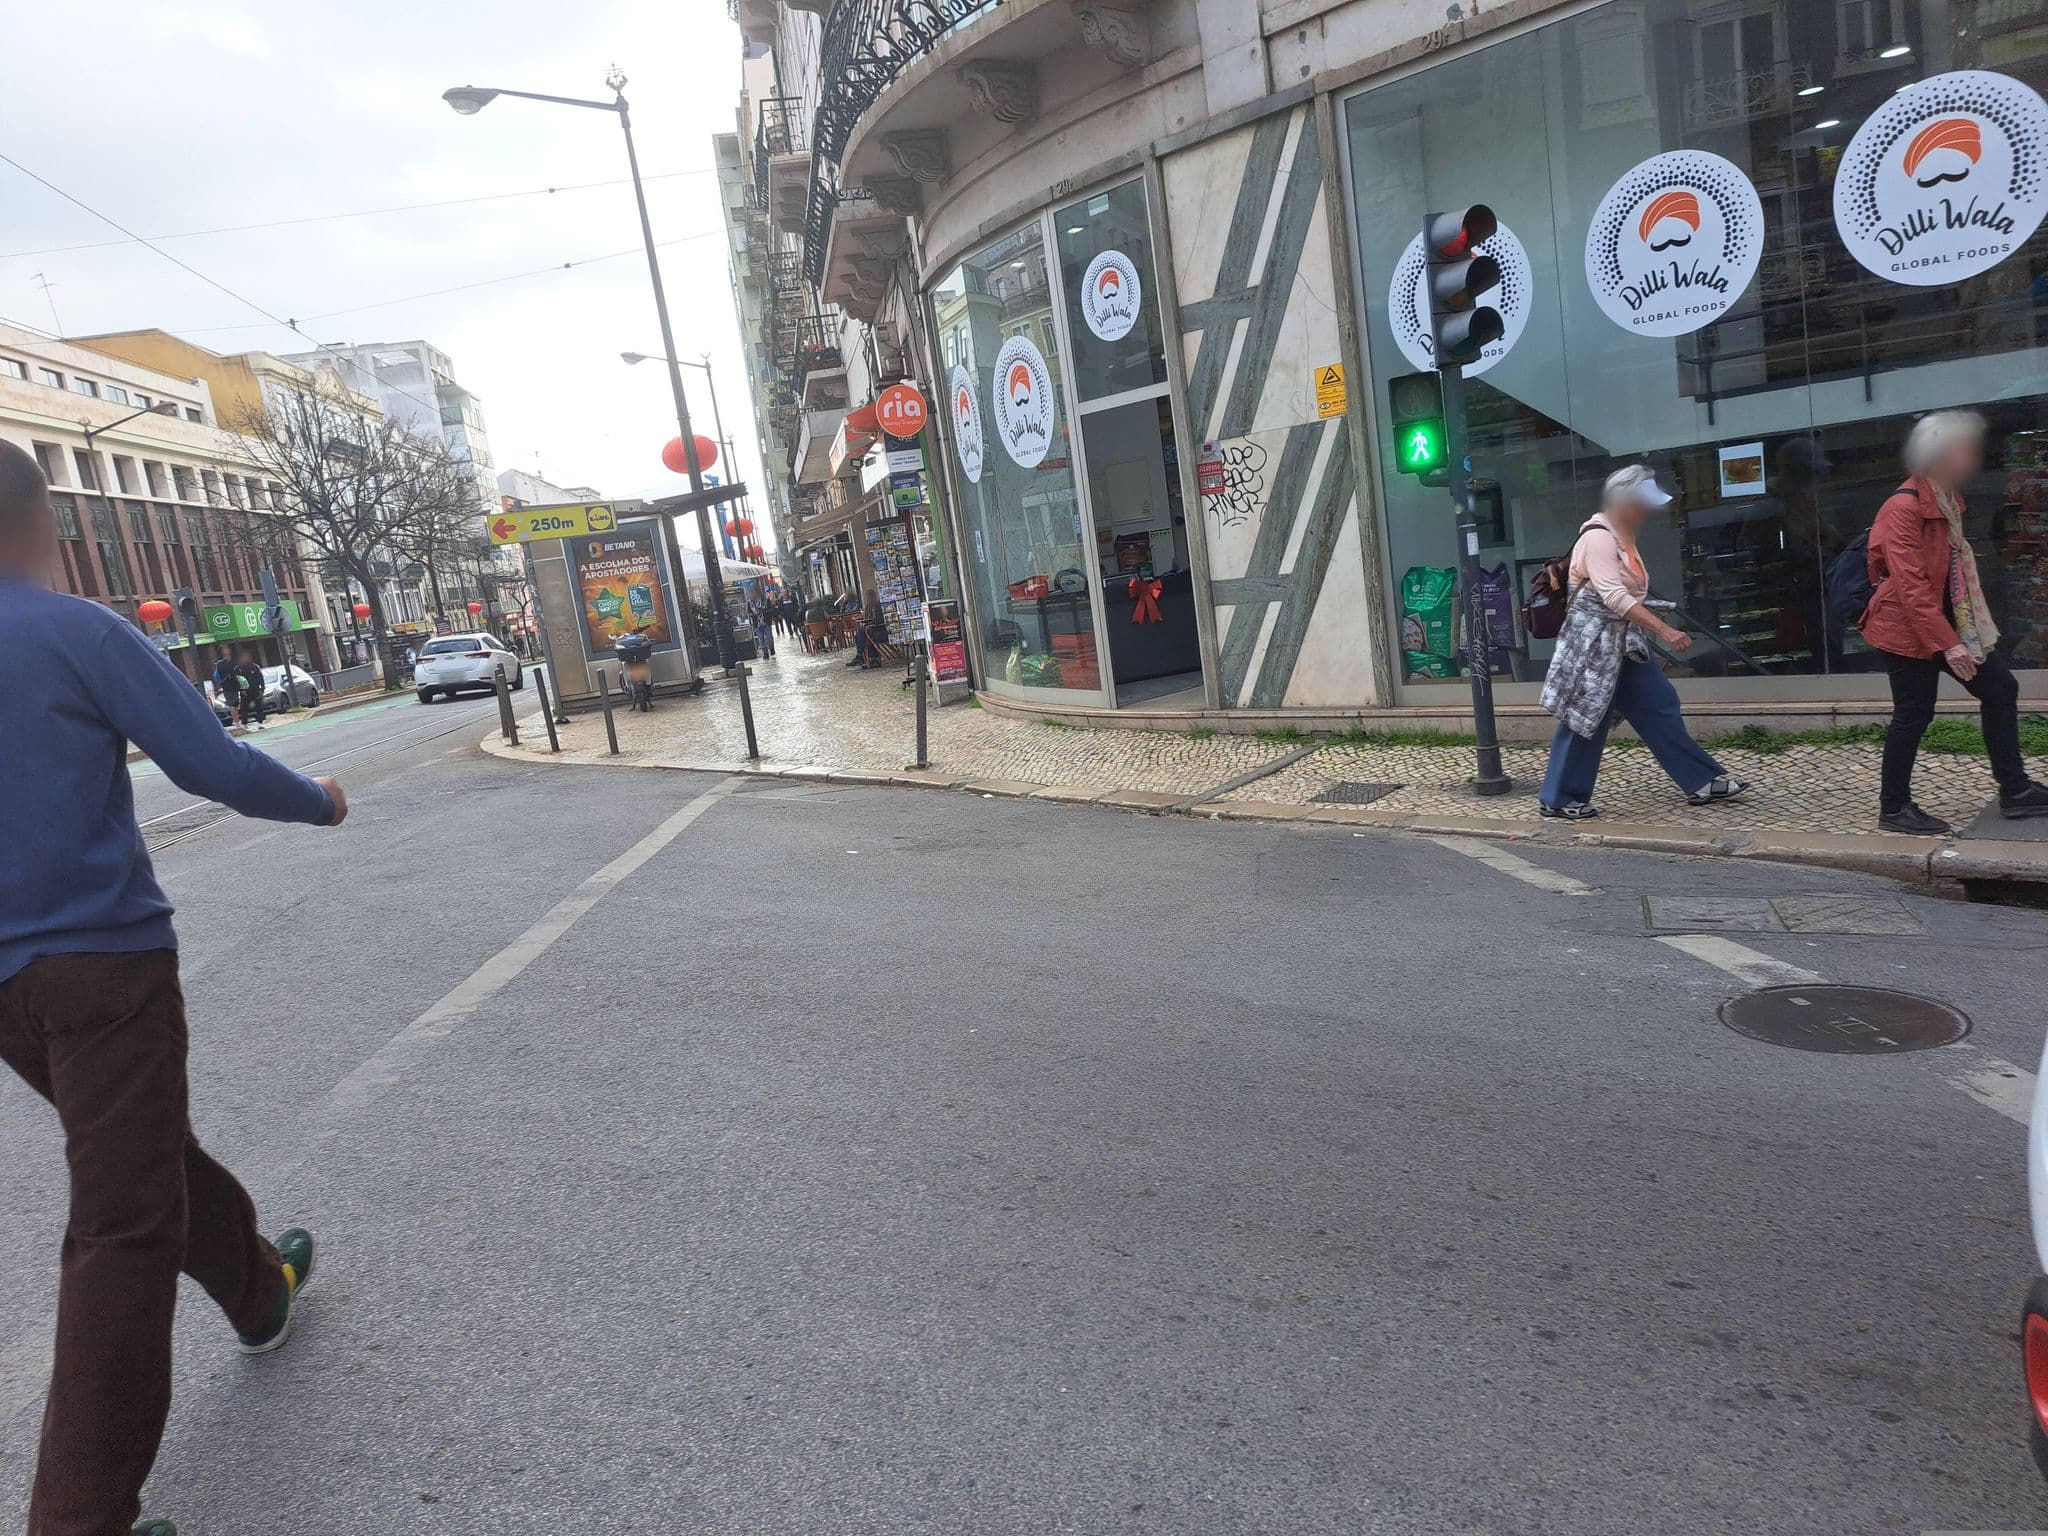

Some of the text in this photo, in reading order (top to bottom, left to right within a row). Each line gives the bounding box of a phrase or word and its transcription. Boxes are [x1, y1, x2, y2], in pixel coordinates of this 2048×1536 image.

[1874, 194, 2015, 256] Dilli Wala
[1891, 243, 2011, 272] GLOBAL FOODS
[1618, 258, 1729, 311] Dilli Wala
[1095, 303, 1132, 328] Dilli Wala
[1632, 301, 1727, 325] GLOBAL FOODS
[883, 391, 921, 418] ria
[1009, 413, 1046, 447] Dilli Wala
[1015, 445, 1047, 458] GLOBAL FOODS
[530, 516, 574, 532] 250m
[604, 540, 636, 552] BETANO
[580, 555, 650, 572] A ESCOLHA DOS
[584, 564, 650, 580] APOSTADORES
